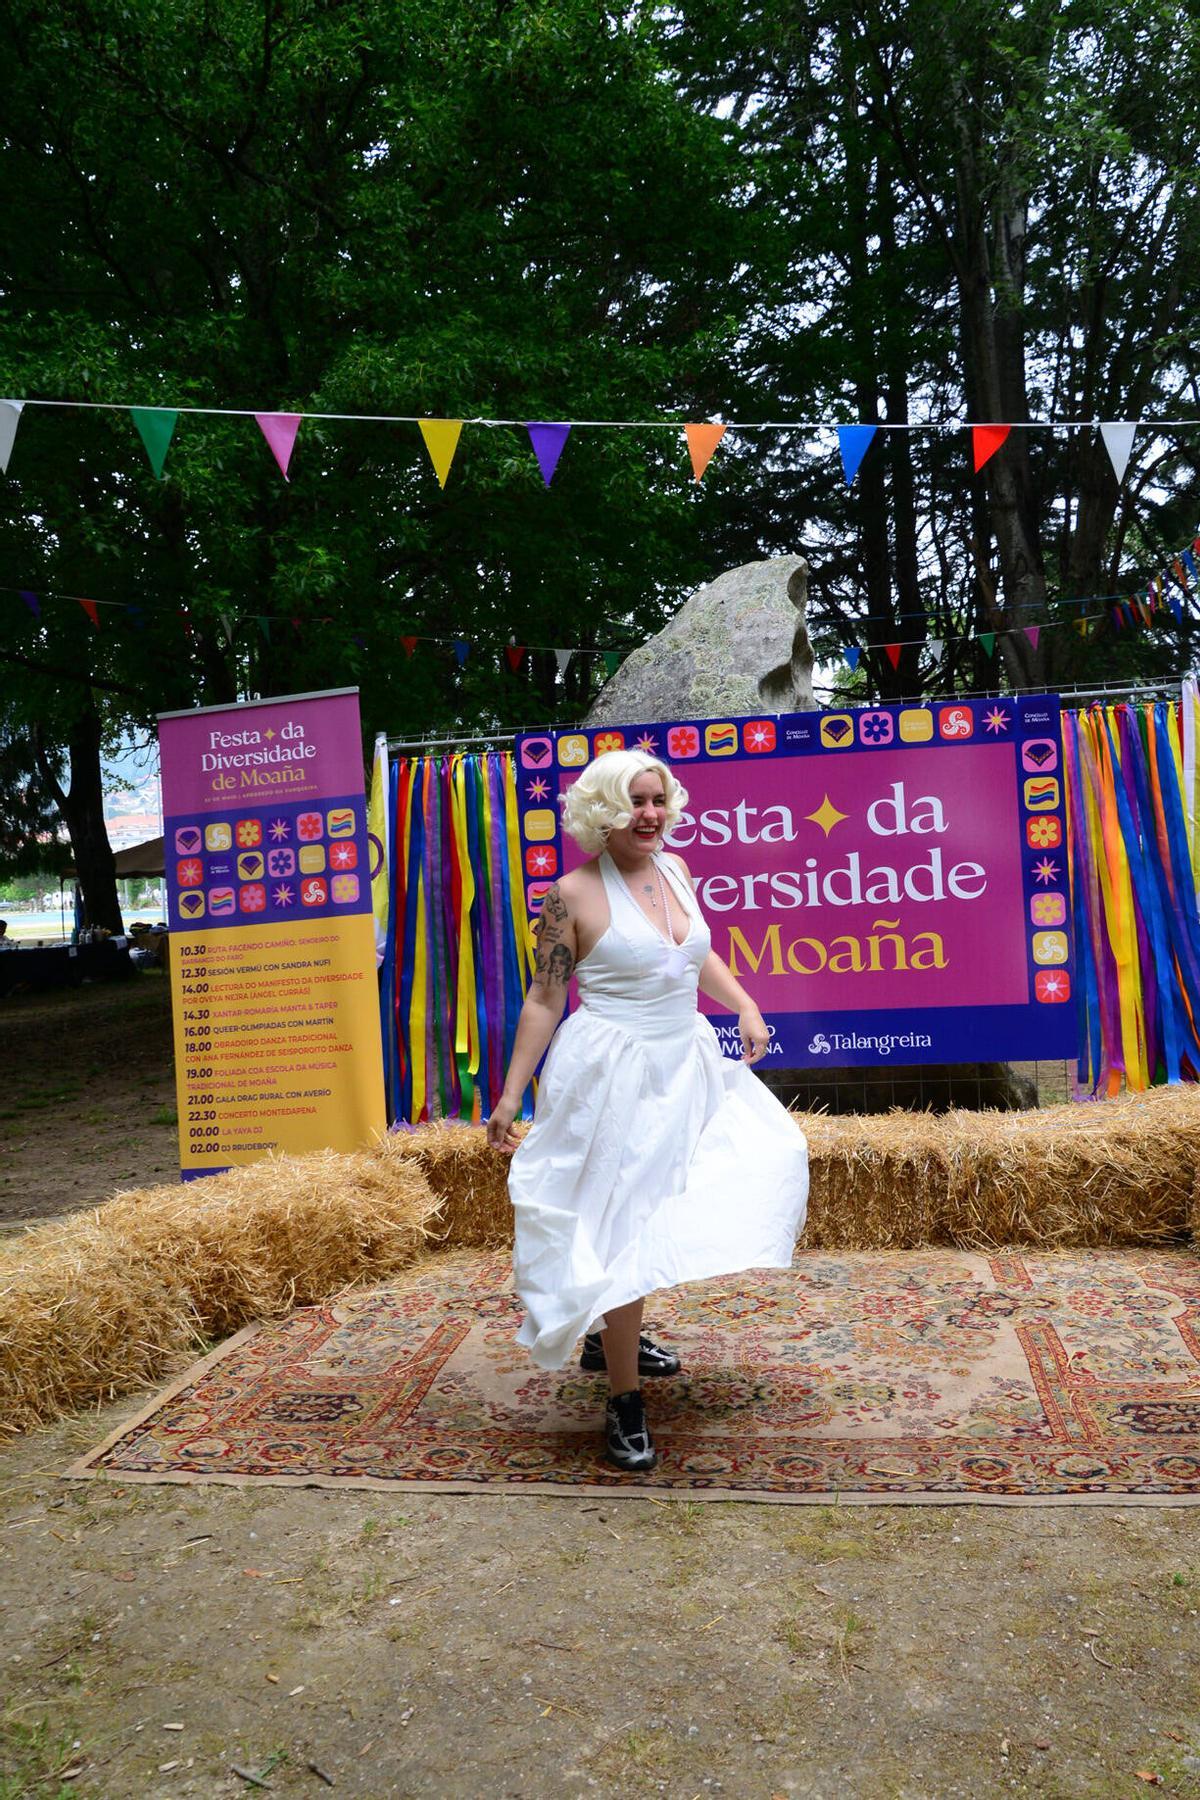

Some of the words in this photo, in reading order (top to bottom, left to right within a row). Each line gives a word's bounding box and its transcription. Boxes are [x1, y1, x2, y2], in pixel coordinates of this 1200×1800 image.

[210, 729, 260, 749] Festa
[281, 722, 305, 740] da
[202, 742, 316, 772] Diversidade
[212, 773, 238, 791] de
[240, 764, 306, 788] Moaña
[663, 798, 798, 848] esta
[866, 782, 949, 836] da
[692, 847, 987, 912] ersidade
[180, 945, 206, 956] 10.30
[229, 943, 263, 951] FACENDO
[728, 918, 950, 976] Moaña
[181, 967, 206, 978] 12.30
[281, 961, 312, 969] SANDRA
[182, 983, 208, 994] 14.00
[211, 984, 244, 992] LECTURA
[258, 978, 299, 987] MANIFESTO
[314, 972, 363, 983] DIVERSIDADE
[184, 1010, 210, 1020] 14.30
[184, 1026, 210, 1037] 16.00
[185, 1042, 211, 1053] 18.00
[214, 1039, 259, 1048] OBRADOIRO
[288, 1033, 336, 1042] TRADICIONAL
[329, 1044, 353, 1052] DANZA
[830, 1032, 931, 1054] Talangreira
[186, 1068, 212, 1079] 19.00
[188, 1095, 213, 1105] 21.00
[188, 1111, 216, 1121] 22.30
[218, 1110, 258, 1120] CONCERTO
[189, 1126, 219, 1137] 00.00
[190, 1143, 219, 1153] 02.00
